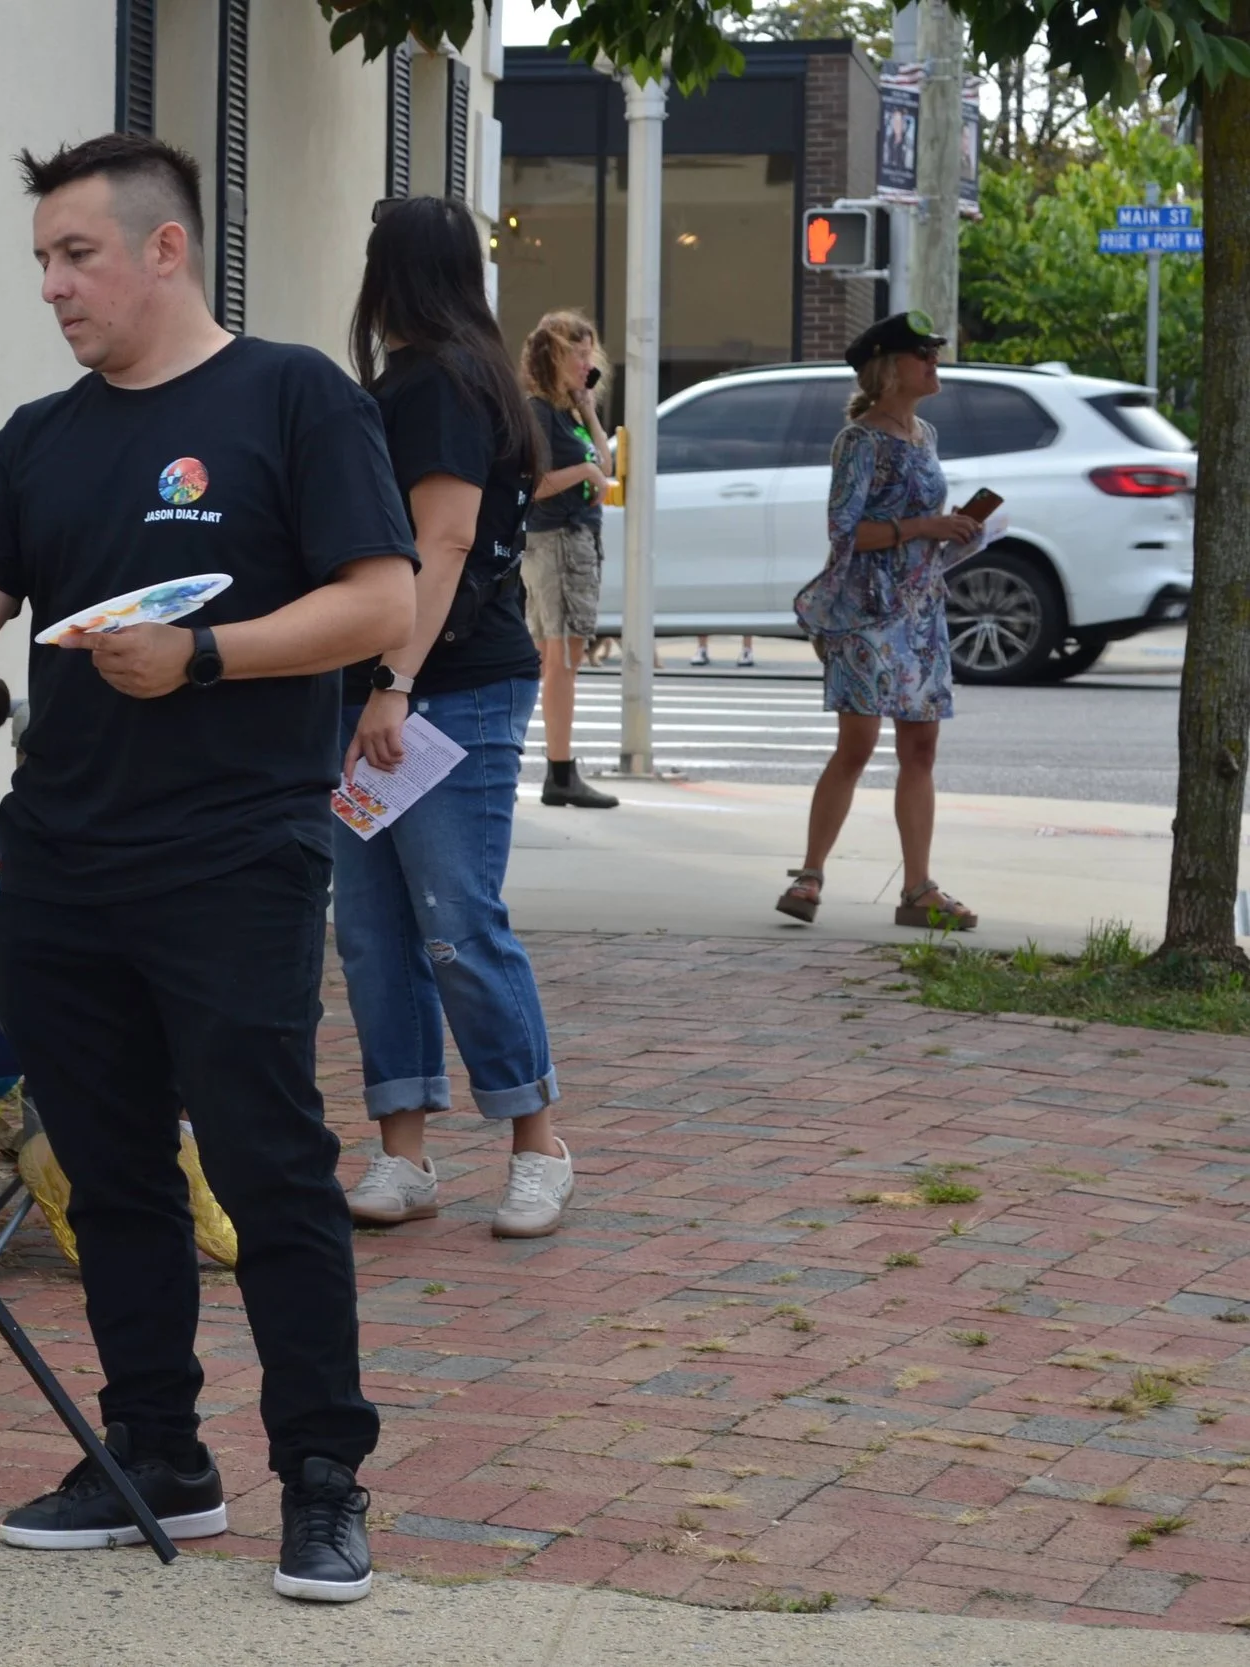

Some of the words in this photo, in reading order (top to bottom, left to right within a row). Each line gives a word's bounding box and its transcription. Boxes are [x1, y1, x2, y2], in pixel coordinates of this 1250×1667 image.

[1119, 209, 1160, 225] MAIN
[1169, 209, 1188, 225] ST
[144, 509, 174, 523] JASON
[175, 508, 199, 520] DIAZ
[200, 511, 222, 523] ART
